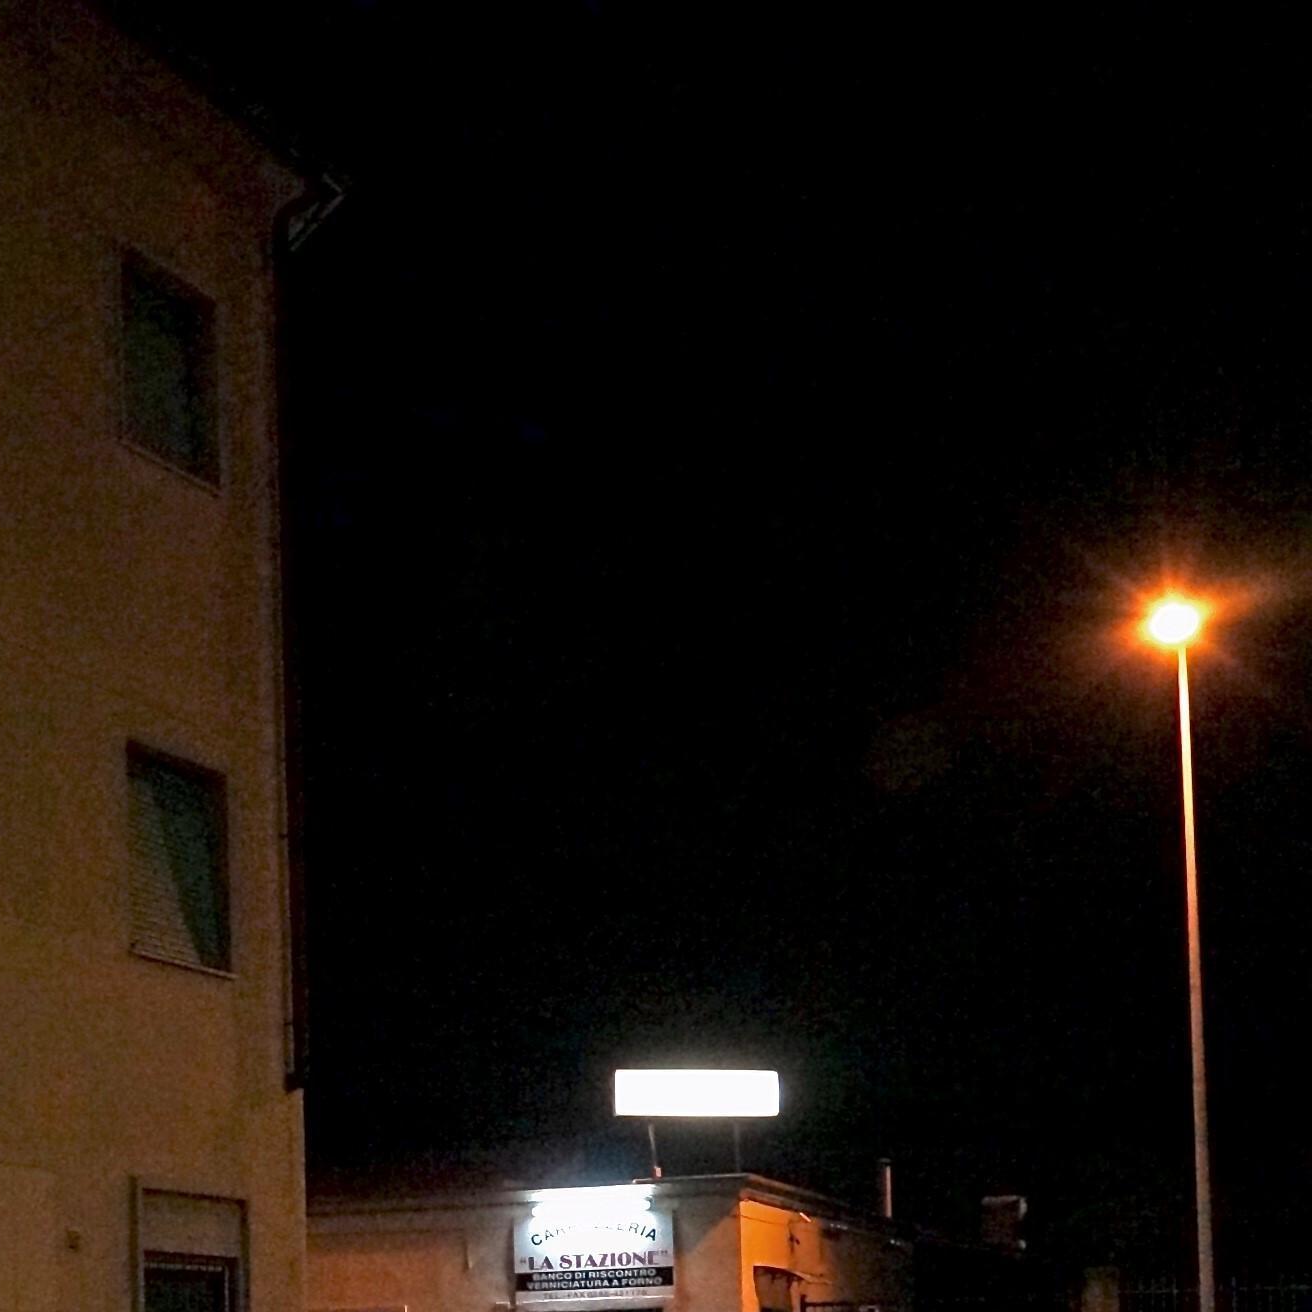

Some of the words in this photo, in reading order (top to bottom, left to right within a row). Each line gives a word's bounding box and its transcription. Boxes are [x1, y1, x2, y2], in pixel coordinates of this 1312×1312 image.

[532, 1271, 572, 1282] BANCO
[575, 1270, 586, 1280] DI
[590, 1268, 656, 1280] RISCONTRO
[527, 1278, 609, 1291] VERNICIATURA
[612, 1278, 620, 1287] A
[622, 1276, 663, 1287] FORNO
